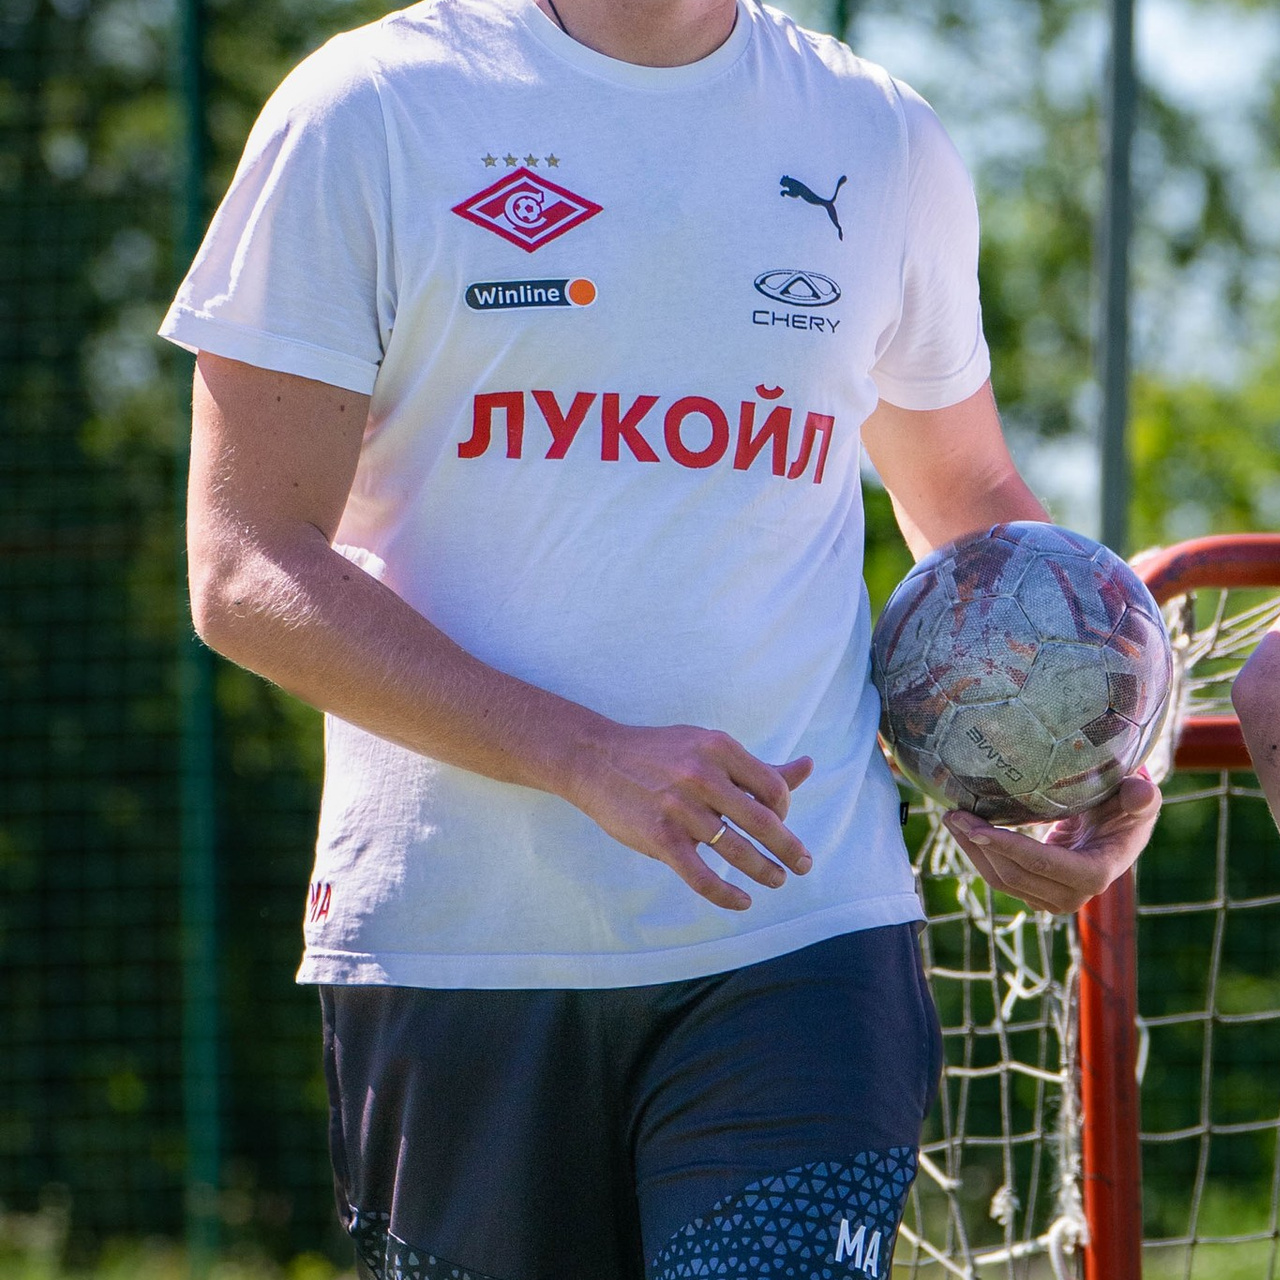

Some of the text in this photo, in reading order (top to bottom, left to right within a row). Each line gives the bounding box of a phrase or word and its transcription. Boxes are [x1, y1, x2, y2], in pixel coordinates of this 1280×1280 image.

[474, 285, 560, 305] Winline
[752, 310, 841, 334] CHERY
[457, 383, 836, 485] ЛУКОЙЛ
[965, 726, 1023, 783] GAME
[834, 1218, 882, 1278] MA
